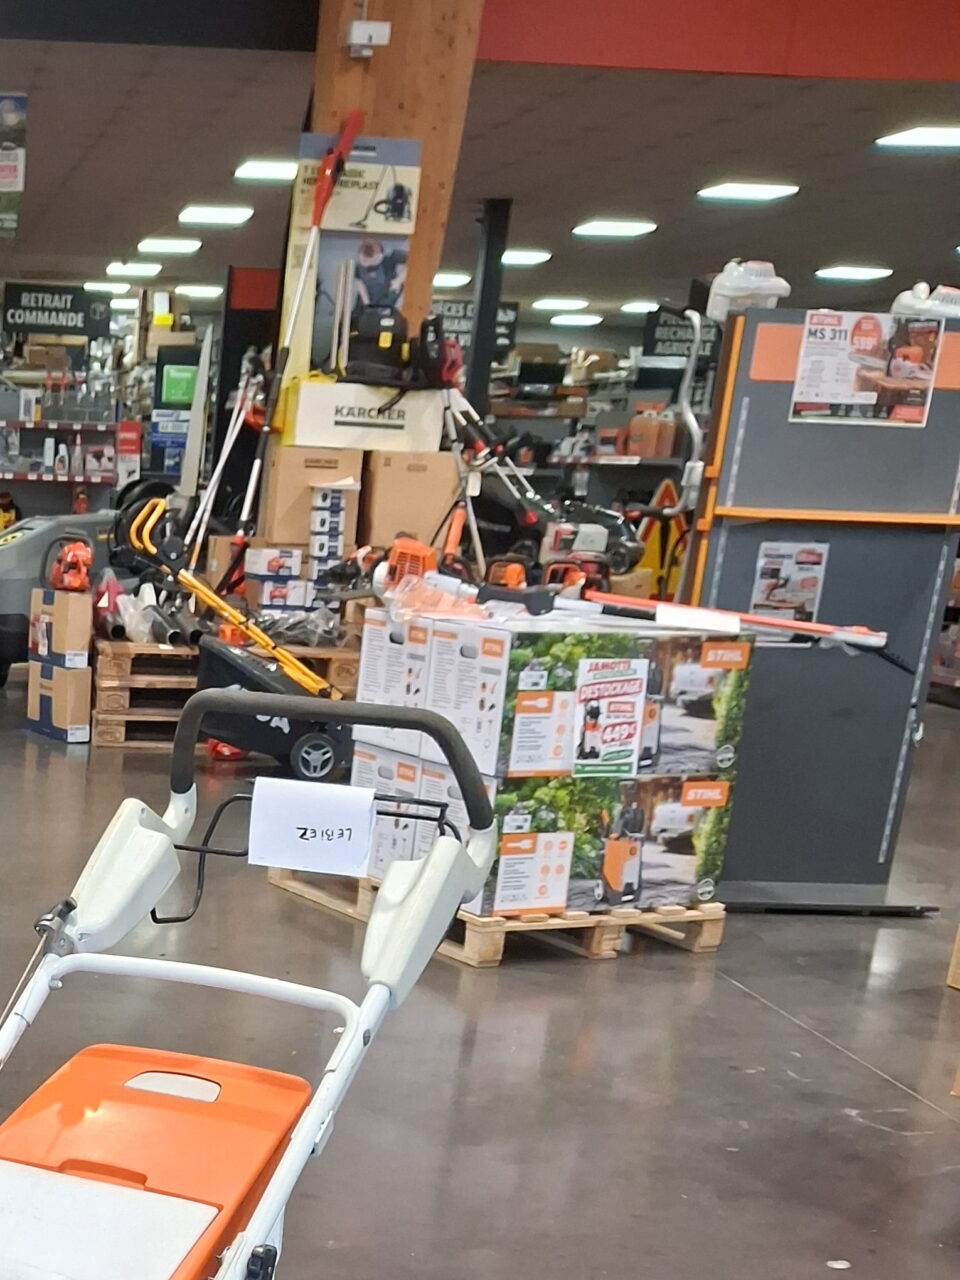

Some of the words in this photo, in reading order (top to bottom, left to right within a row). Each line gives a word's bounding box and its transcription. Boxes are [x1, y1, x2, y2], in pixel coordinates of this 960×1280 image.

[21, 291, 74, 310] RETRAIT
[6, 308, 85, 328] COMMANDE
[807, 328, 827, 340] MS
[830, 328, 848, 341] 311
[707, 649, 743, 662] STIHL
[686, 788, 722, 801] STIHL
